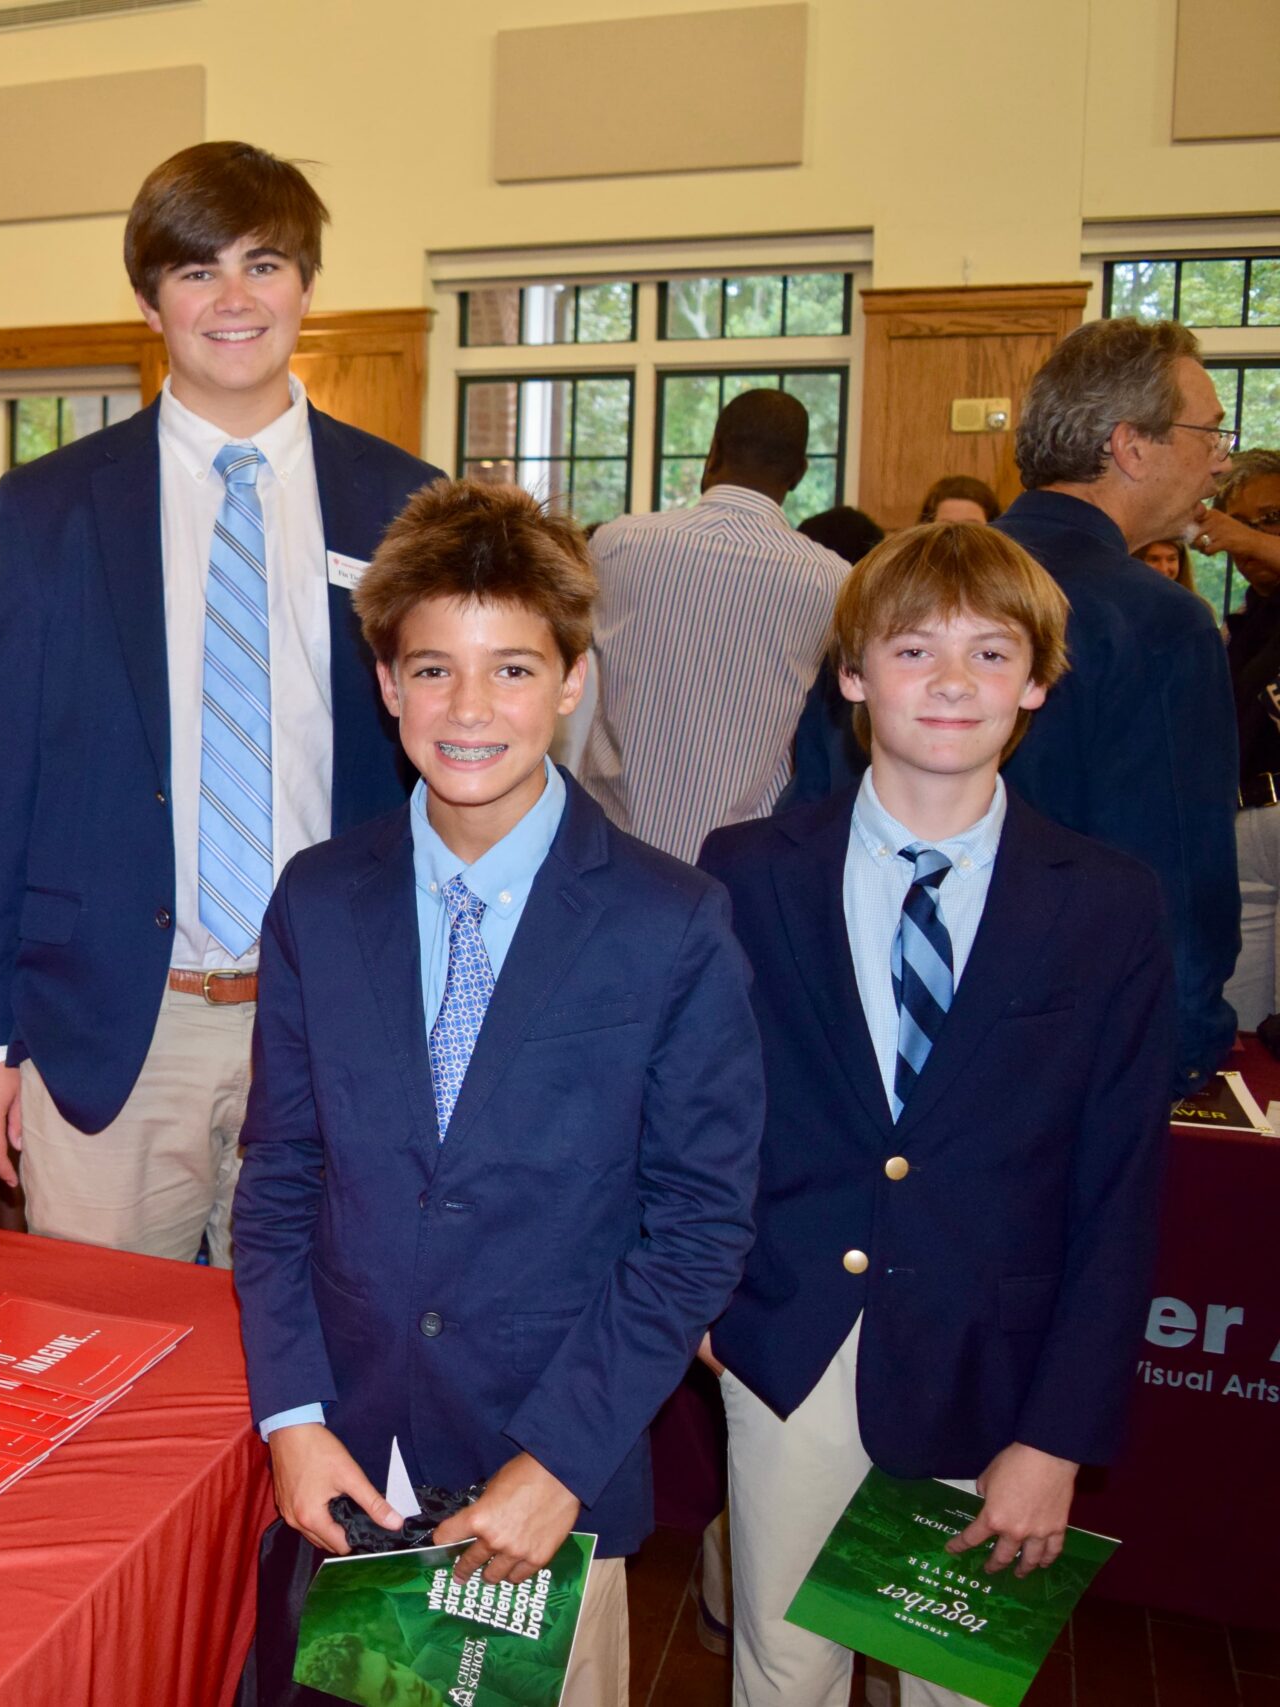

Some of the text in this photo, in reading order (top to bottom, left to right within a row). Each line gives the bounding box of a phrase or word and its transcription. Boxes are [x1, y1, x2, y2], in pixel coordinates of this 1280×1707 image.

[12, 1329, 102, 1375] IMAGINE...
[1221, 1374, 1280, 1403] Arts
[911, 1513, 961, 1536] CHOOL
[427, 1568, 448, 1610] where
[907, 1556, 993, 1594] FOREVER
[917, 1575, 969, 1599] NOW AND
[522, 1568, 552, 1641] brothers
[877, 1583, 989, 1633] together
[894, 1612, 950, 1638] STRONGER
[457, 1636, 476, 1686] CHRIST
[467, 1638, 488, 1690] SCHOOL
